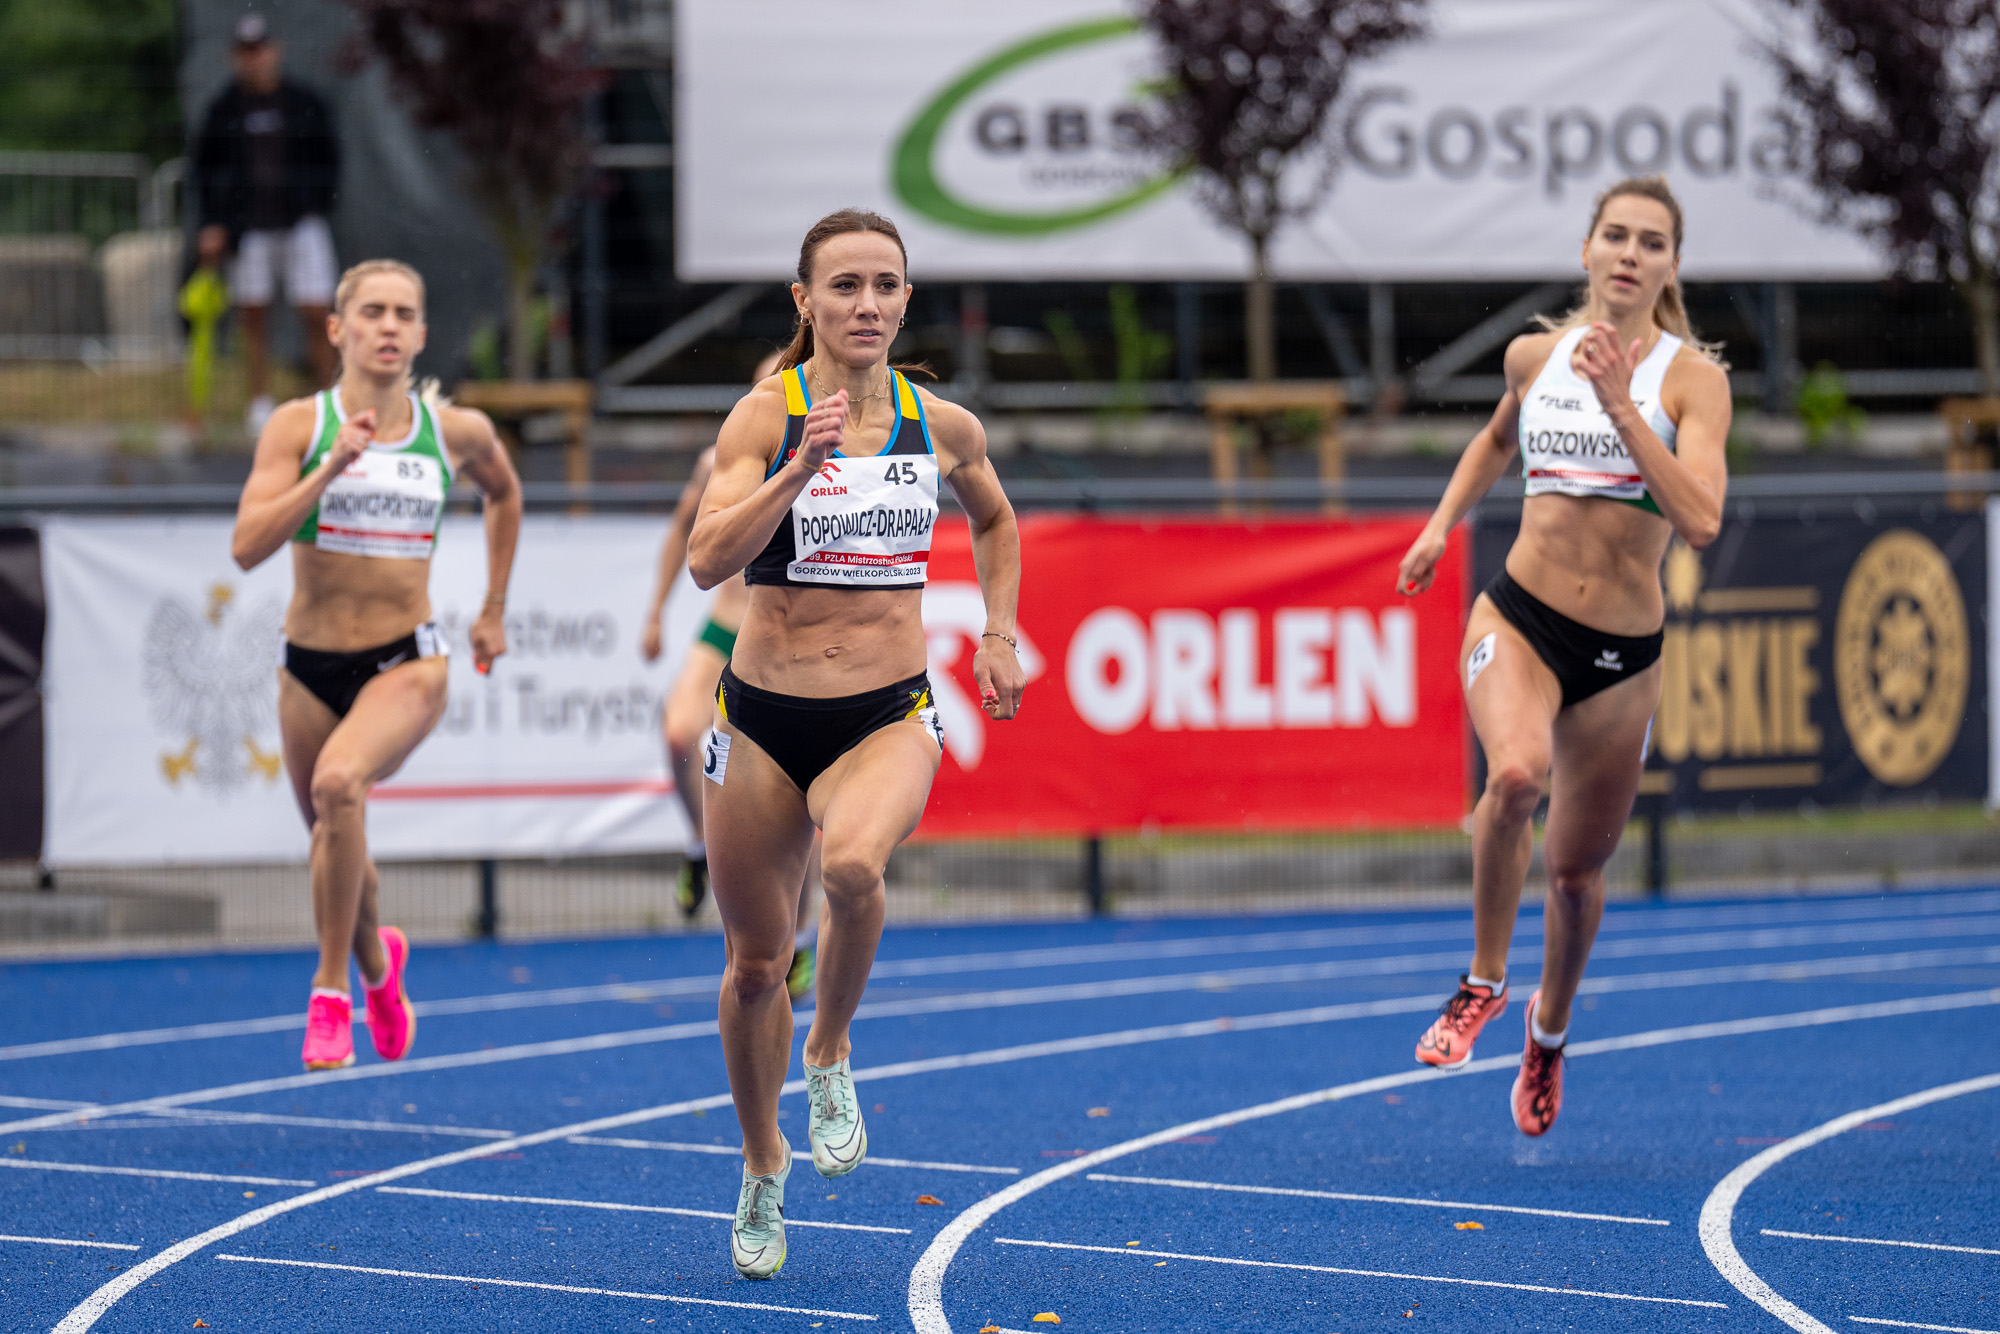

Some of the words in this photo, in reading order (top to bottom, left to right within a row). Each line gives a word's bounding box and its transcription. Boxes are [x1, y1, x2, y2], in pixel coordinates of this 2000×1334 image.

[1528, 430, 1633, 460] ŁOZOWSK
[398, 460, 425, 480] 85
[884, 462, 918, 485] 45
[810, 486, 848, 498] ORLEN
[801, 508, 932, 546] POPOWICZ-DRAPAŁA
[824, 553, 846, 564] PZLA
[895, 553, 914, 564] Polski
[794, 565, 840, 576] GORZÓW
[905, 567, 921, 576] 2023
[1066, 606, 1418, 734] ORLEN
